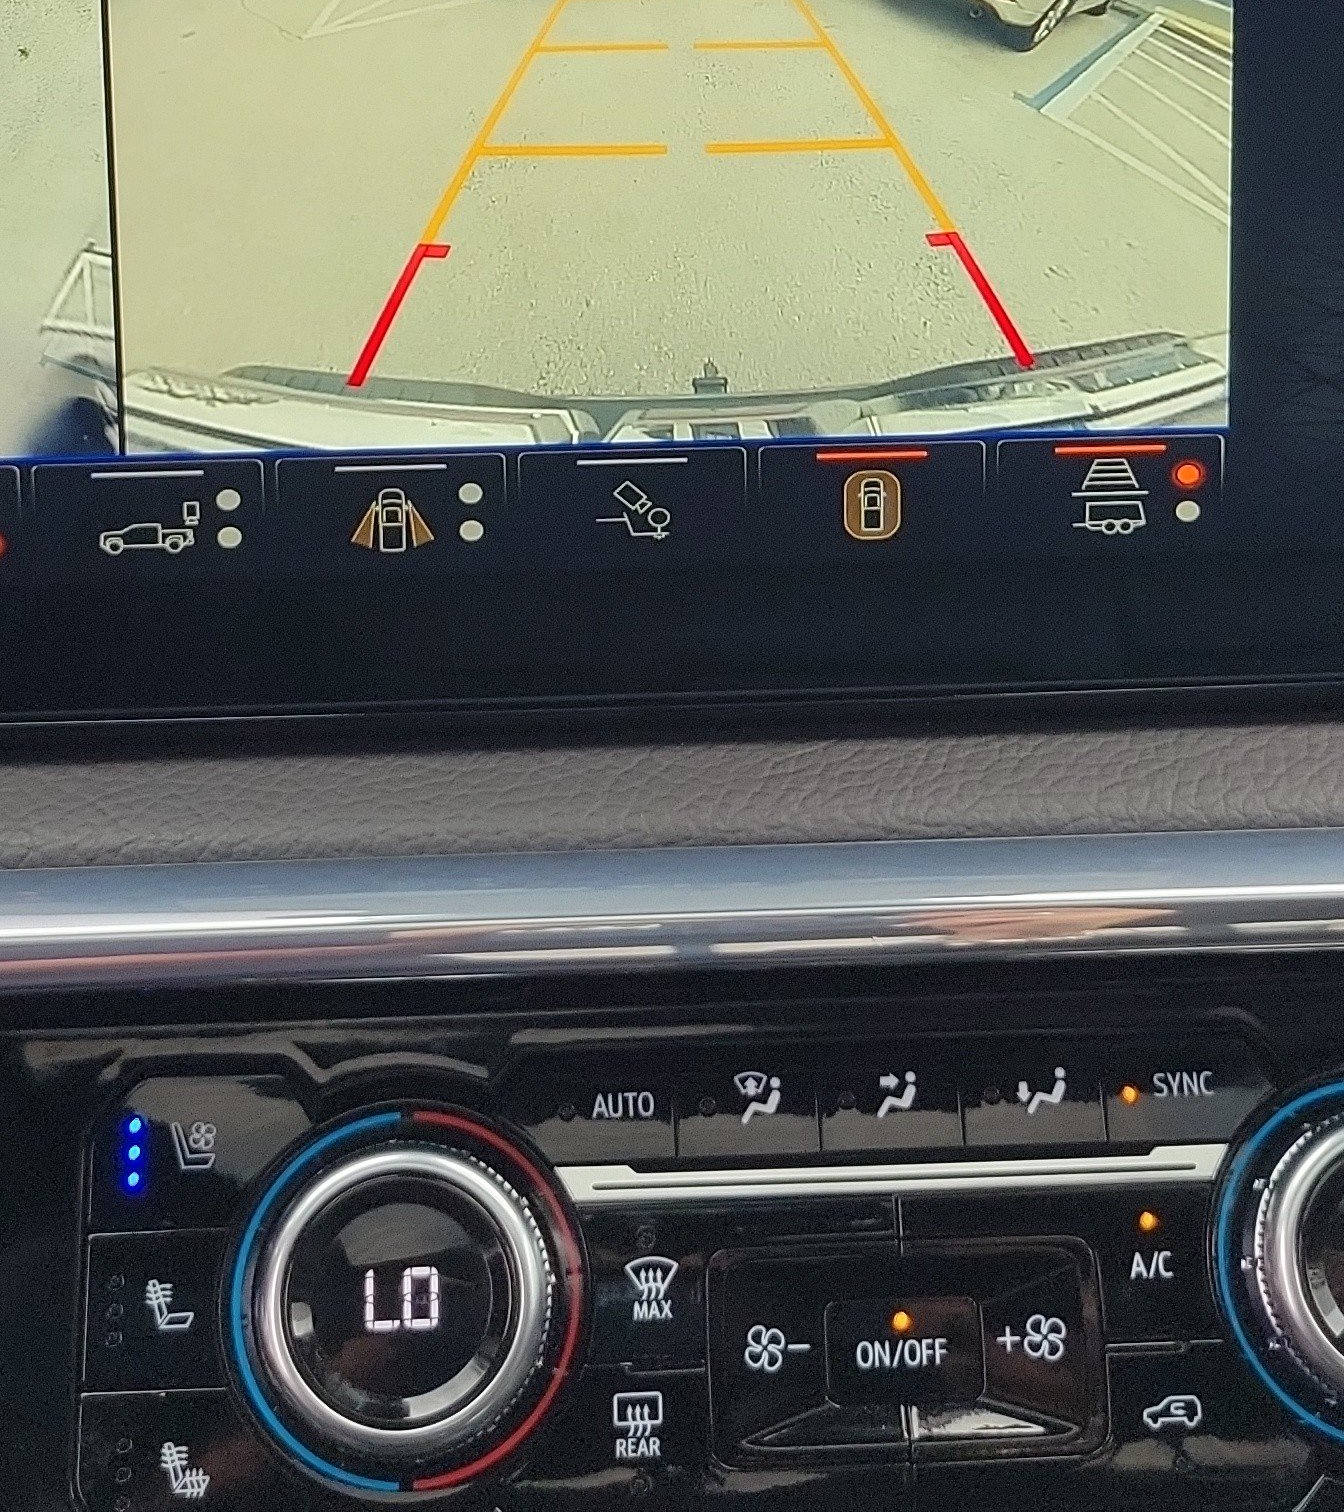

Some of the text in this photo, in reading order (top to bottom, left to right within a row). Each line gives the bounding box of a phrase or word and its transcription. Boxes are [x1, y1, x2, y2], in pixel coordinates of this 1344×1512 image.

[1152, 1070, 1214, 1099] SYNC
[592, 1091, 656, 1119] AUTO
[1130, 1250, 1174, 1280] A/C
[364, 1266, 441, 1332] LO
[633, 1296, 674, 1321] MAX
[856, 1337, 948, 1368] ON/OFF
[616, 1438, 662, 1461] REAR
